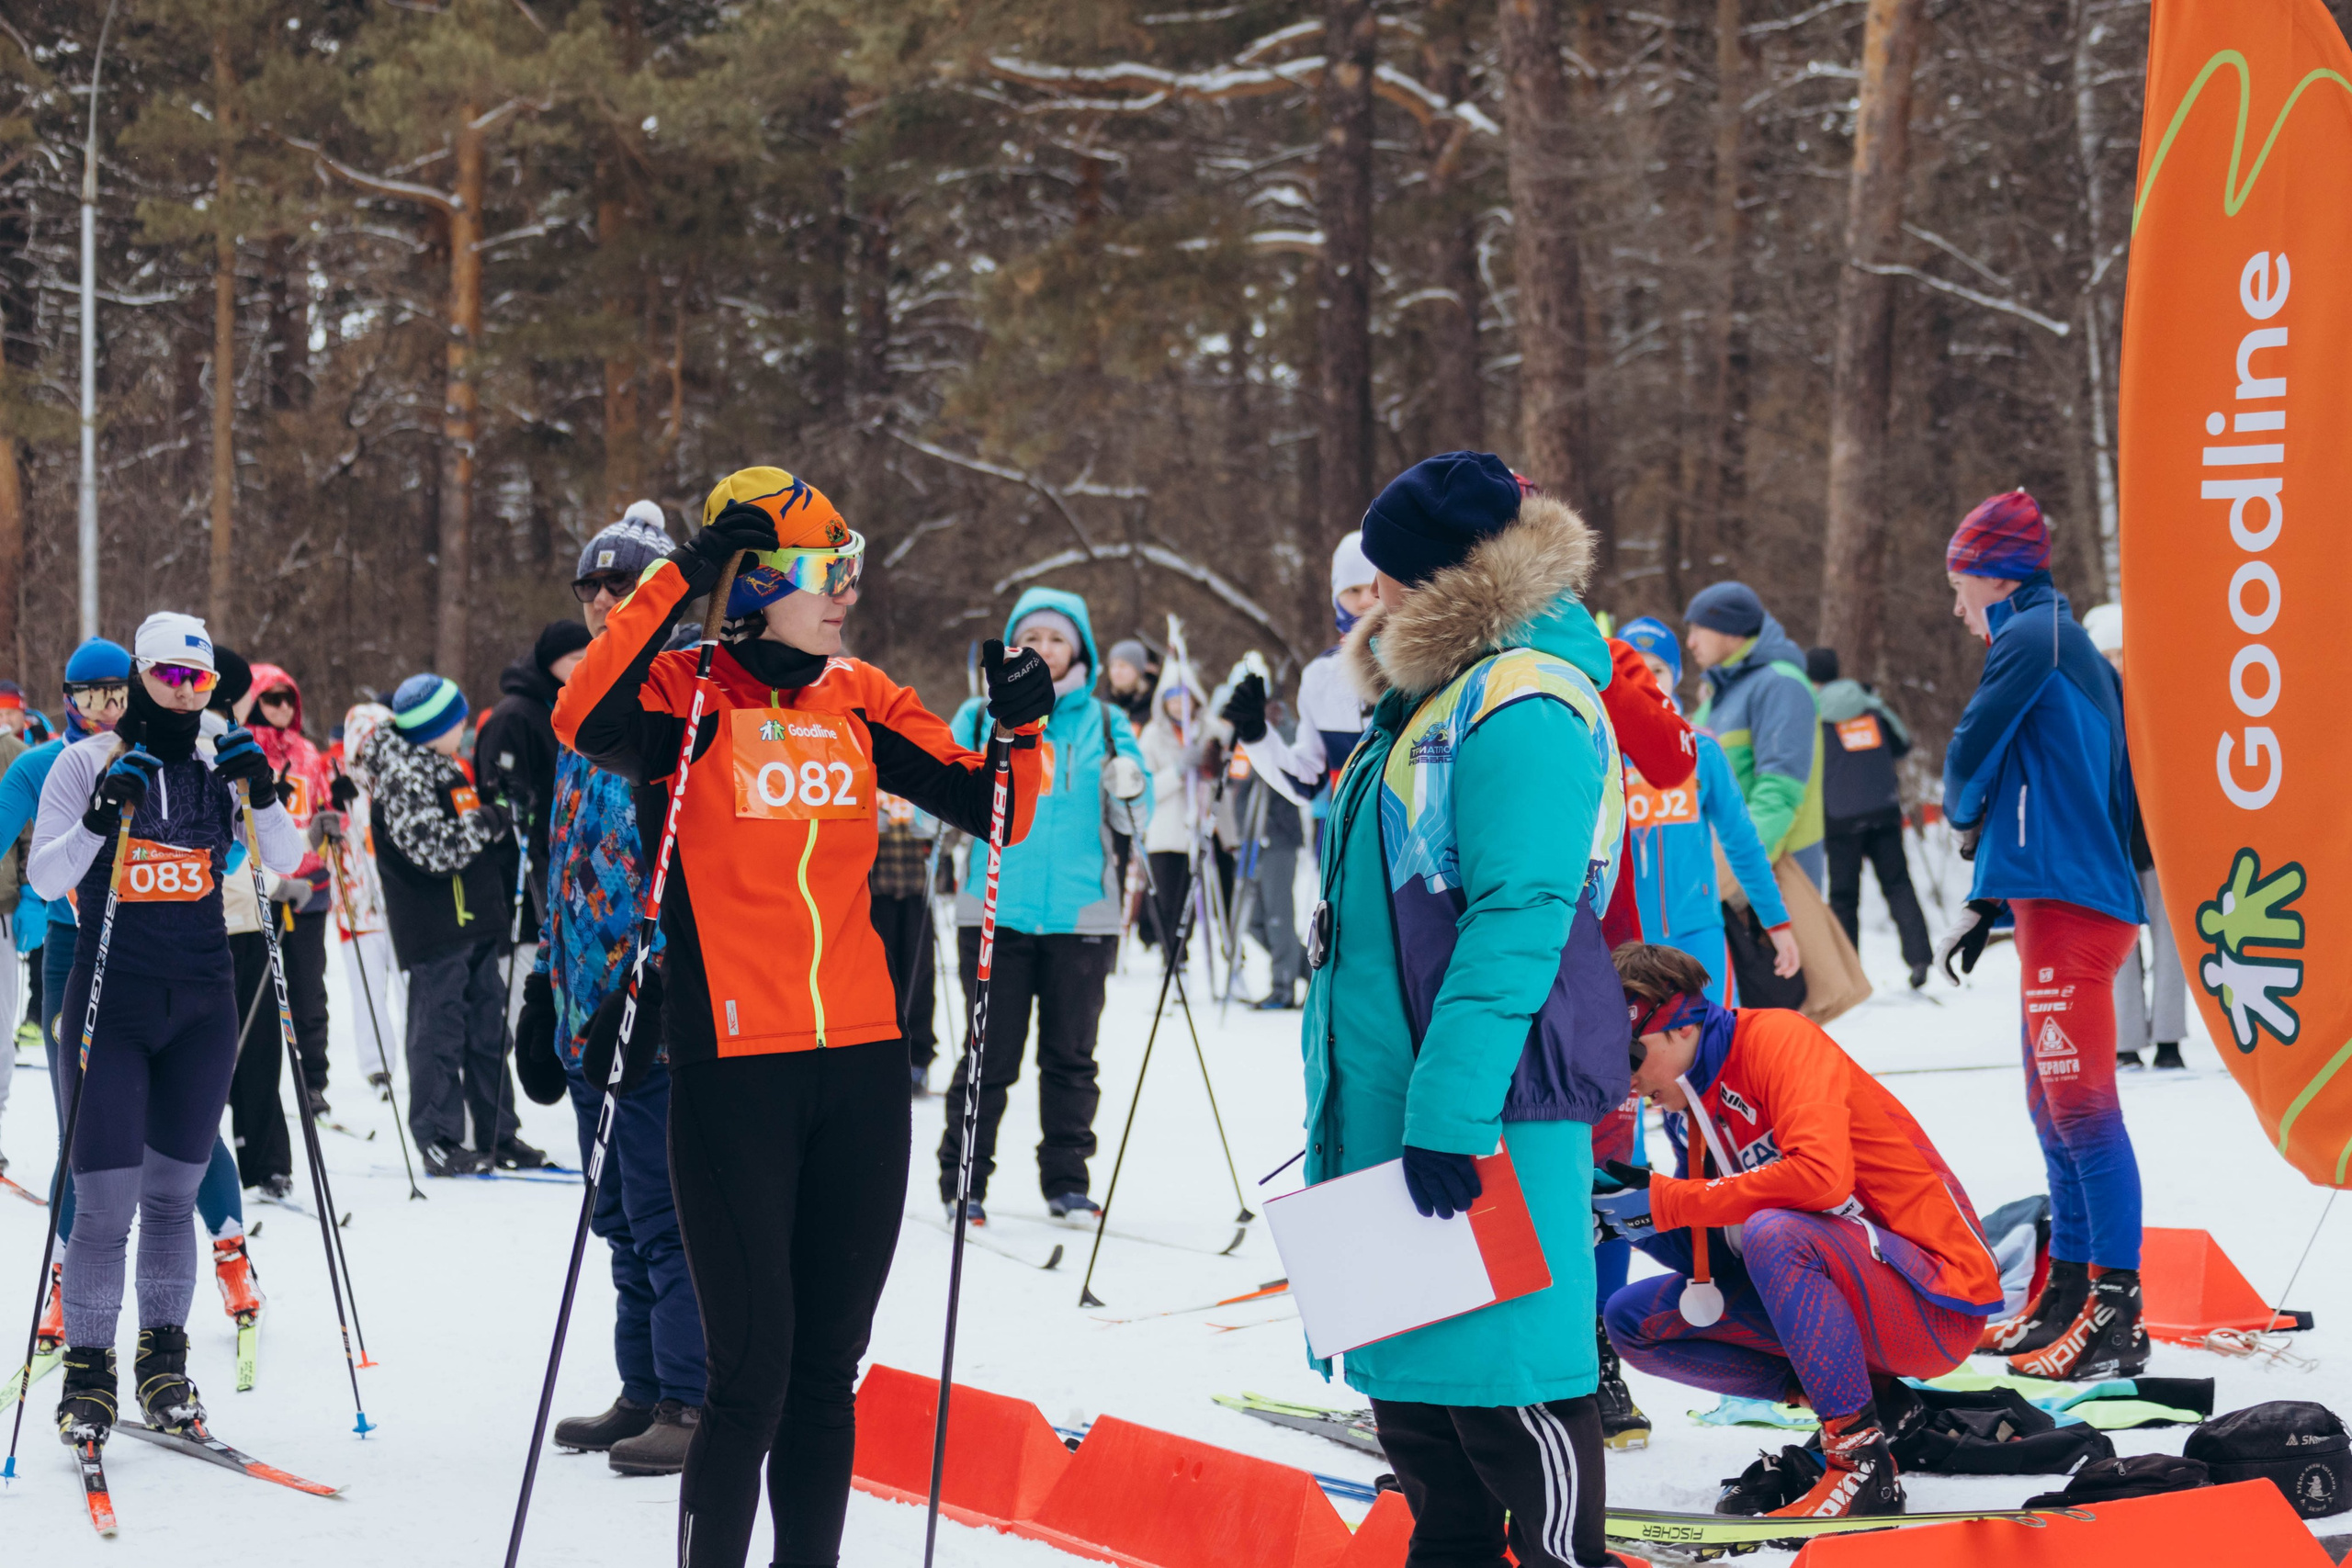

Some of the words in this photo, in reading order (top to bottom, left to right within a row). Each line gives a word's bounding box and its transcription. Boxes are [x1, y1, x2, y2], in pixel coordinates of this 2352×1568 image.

[2201, 251, 2290, 810] Goodline
[1007, 660, 1035, 682] CRAFT
[788, 723, 838, 739] Goodline
[1410, 745, 1453, 759] ТРИАТЛО
[757, 761, 857, 807] 082
[130, 862, 203, 893] 083
[2023, 1303, 2116, 1376] alpina
[1642, 1524, 1704, 1540] FISCHER
